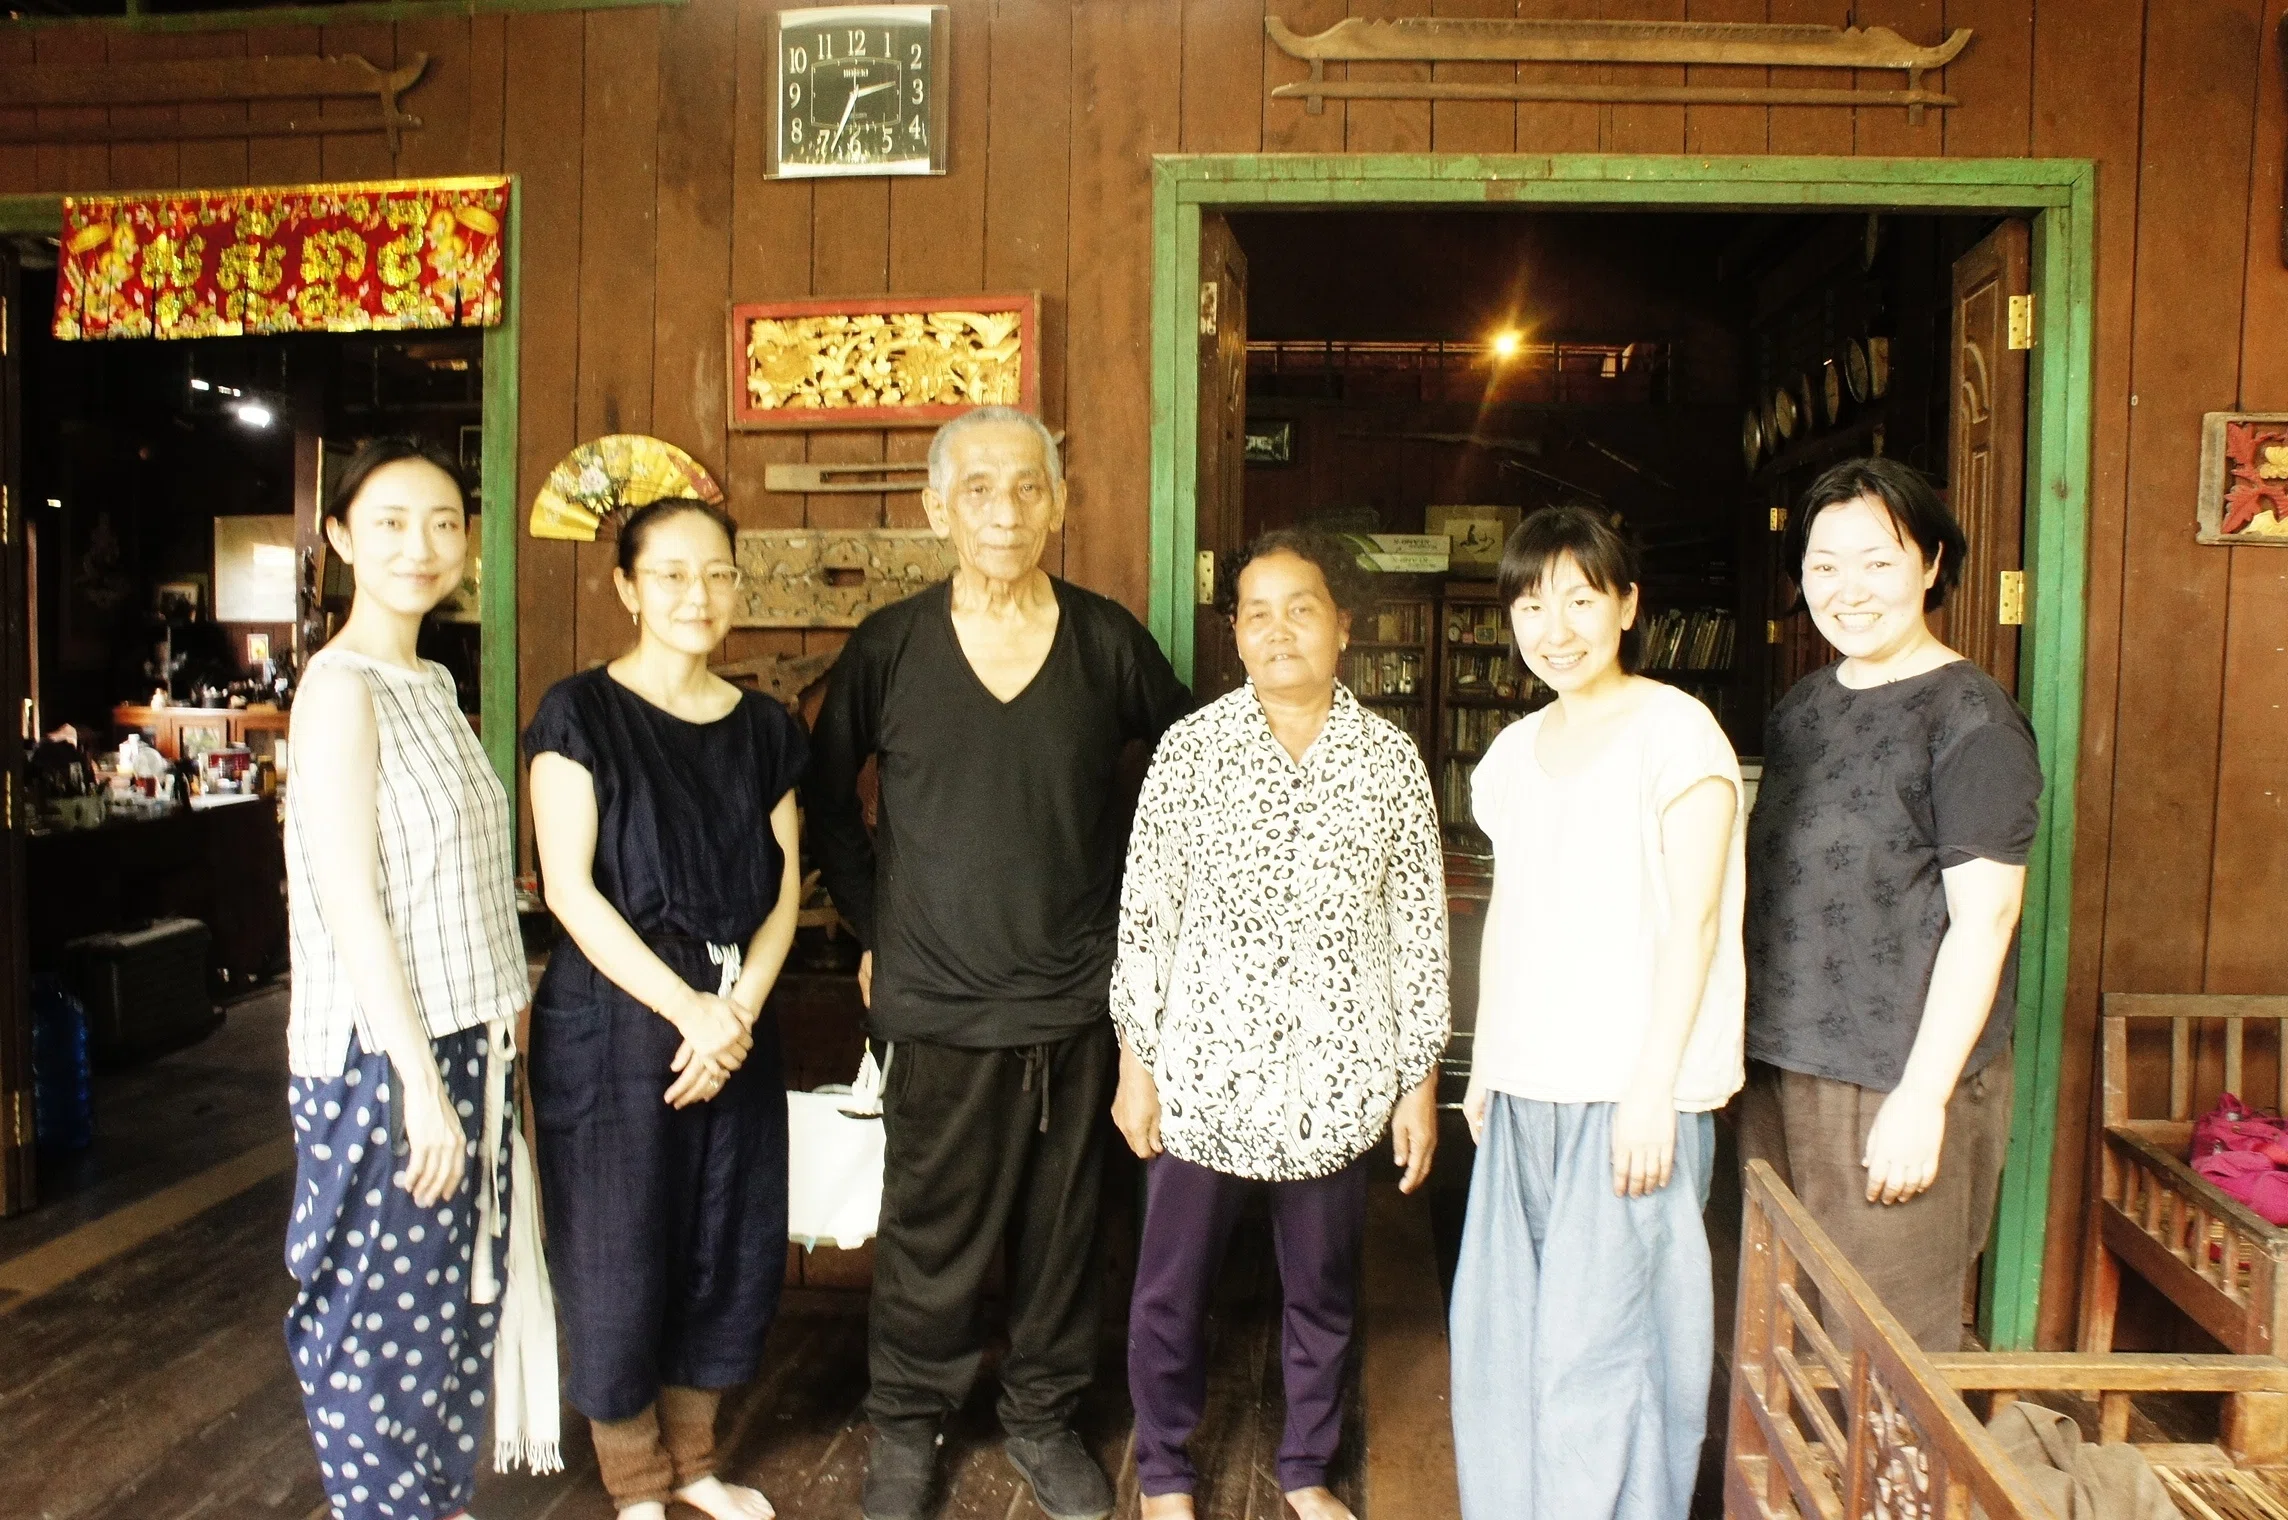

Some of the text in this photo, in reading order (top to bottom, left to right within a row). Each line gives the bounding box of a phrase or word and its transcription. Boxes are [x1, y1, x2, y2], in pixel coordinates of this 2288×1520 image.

[818, 34, 832, 60] 11
[848, 30, 866, 56] 12
[884, 32, 891, 58] 1
[790, 47, 807, 74] 10
[910, 44, 922, 70] 2
[789, 83, 801, 109] 9
[912, 79, 923, 105] 3
[791, 118, 803, 144] 8
[882, 127, 893, 153] 5
[909, 115, 921, 140] 4
[819, 129, 831, 157] 7
[849, 125, 862, 159] 6
